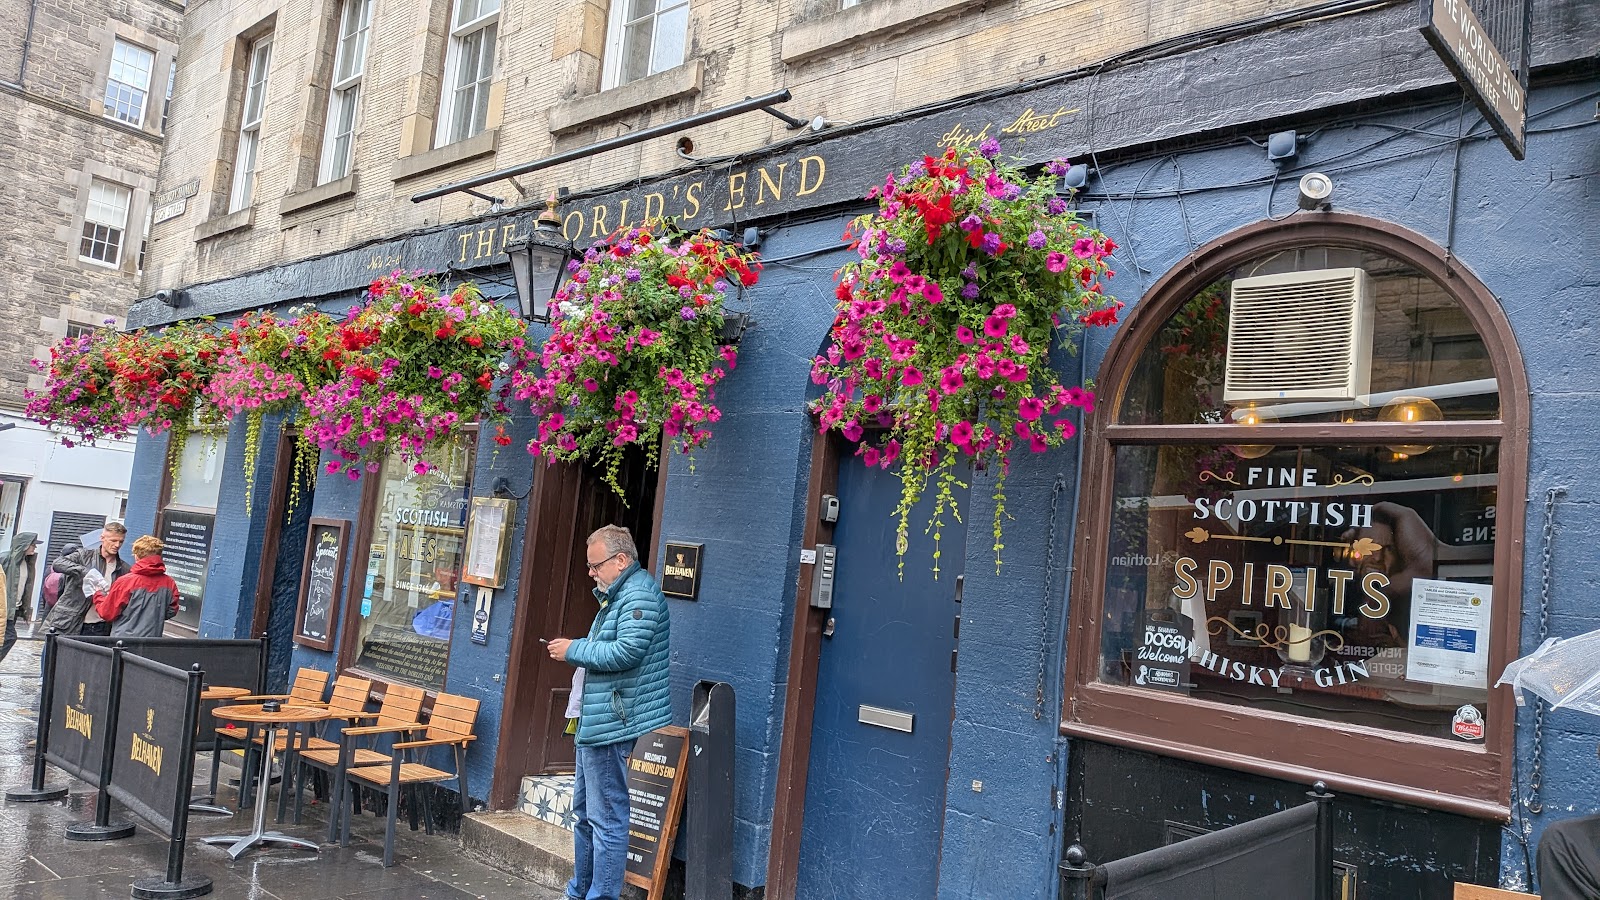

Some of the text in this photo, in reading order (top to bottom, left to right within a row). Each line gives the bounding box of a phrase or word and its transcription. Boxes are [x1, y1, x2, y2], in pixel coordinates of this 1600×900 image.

[1458, 39, 1500, 109] HIGH STREET
[1460, 7, 1501, 85] WORLD'S
[1502, 72, 1520, 111] END
[937, 106, 1081, 147] High Street
[458, 155, 826, 263] THE ORLD'S END
[1247, 467, 1317, 487] FINE
[395, 507, 449, 528] SCOTTISH
[1193, 497, 1374, 528] SCOTTISH
[398, 534, 437, 564] ALES
[395, 580, 414, 591] SINCE
[664, 564, 694, 579] BELHAVEN
[1172, 556, 1391, 619] SPIRITS
[1138, 646, 1185, 663] Welcome
[1144, 631, 1182, 649] DOGS
[1178, 635, 1370, 688] WHISKY GIN
[65, 704, 93, 740] BELHAVEN
[130, 732, 164, 777] BELHAVEN
[631, 758, 676, 779] THE WORLD'S END
[644, 752, 667, 764] WELCOME TO
